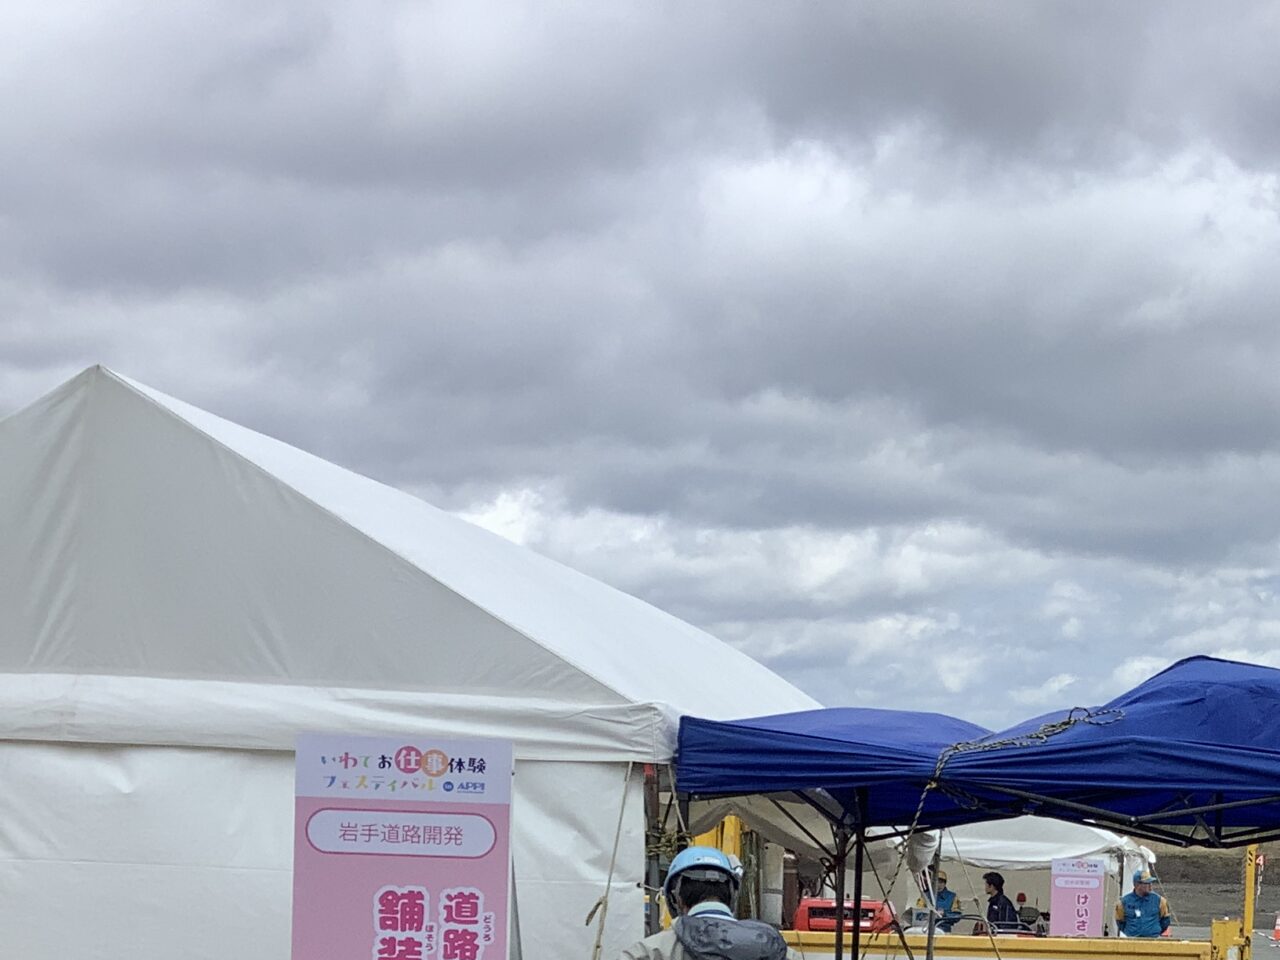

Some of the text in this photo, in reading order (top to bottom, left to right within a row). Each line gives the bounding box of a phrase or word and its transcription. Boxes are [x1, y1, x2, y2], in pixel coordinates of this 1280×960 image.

[323, 775, 438, 792] フェスティバル
[457, 782, 486, 791] APPI
[338, 822, 464, 846] 岩手道路開発
[1076, 894, 1089, 937] けいさ
[425, 924, 434, 951] ほそう
